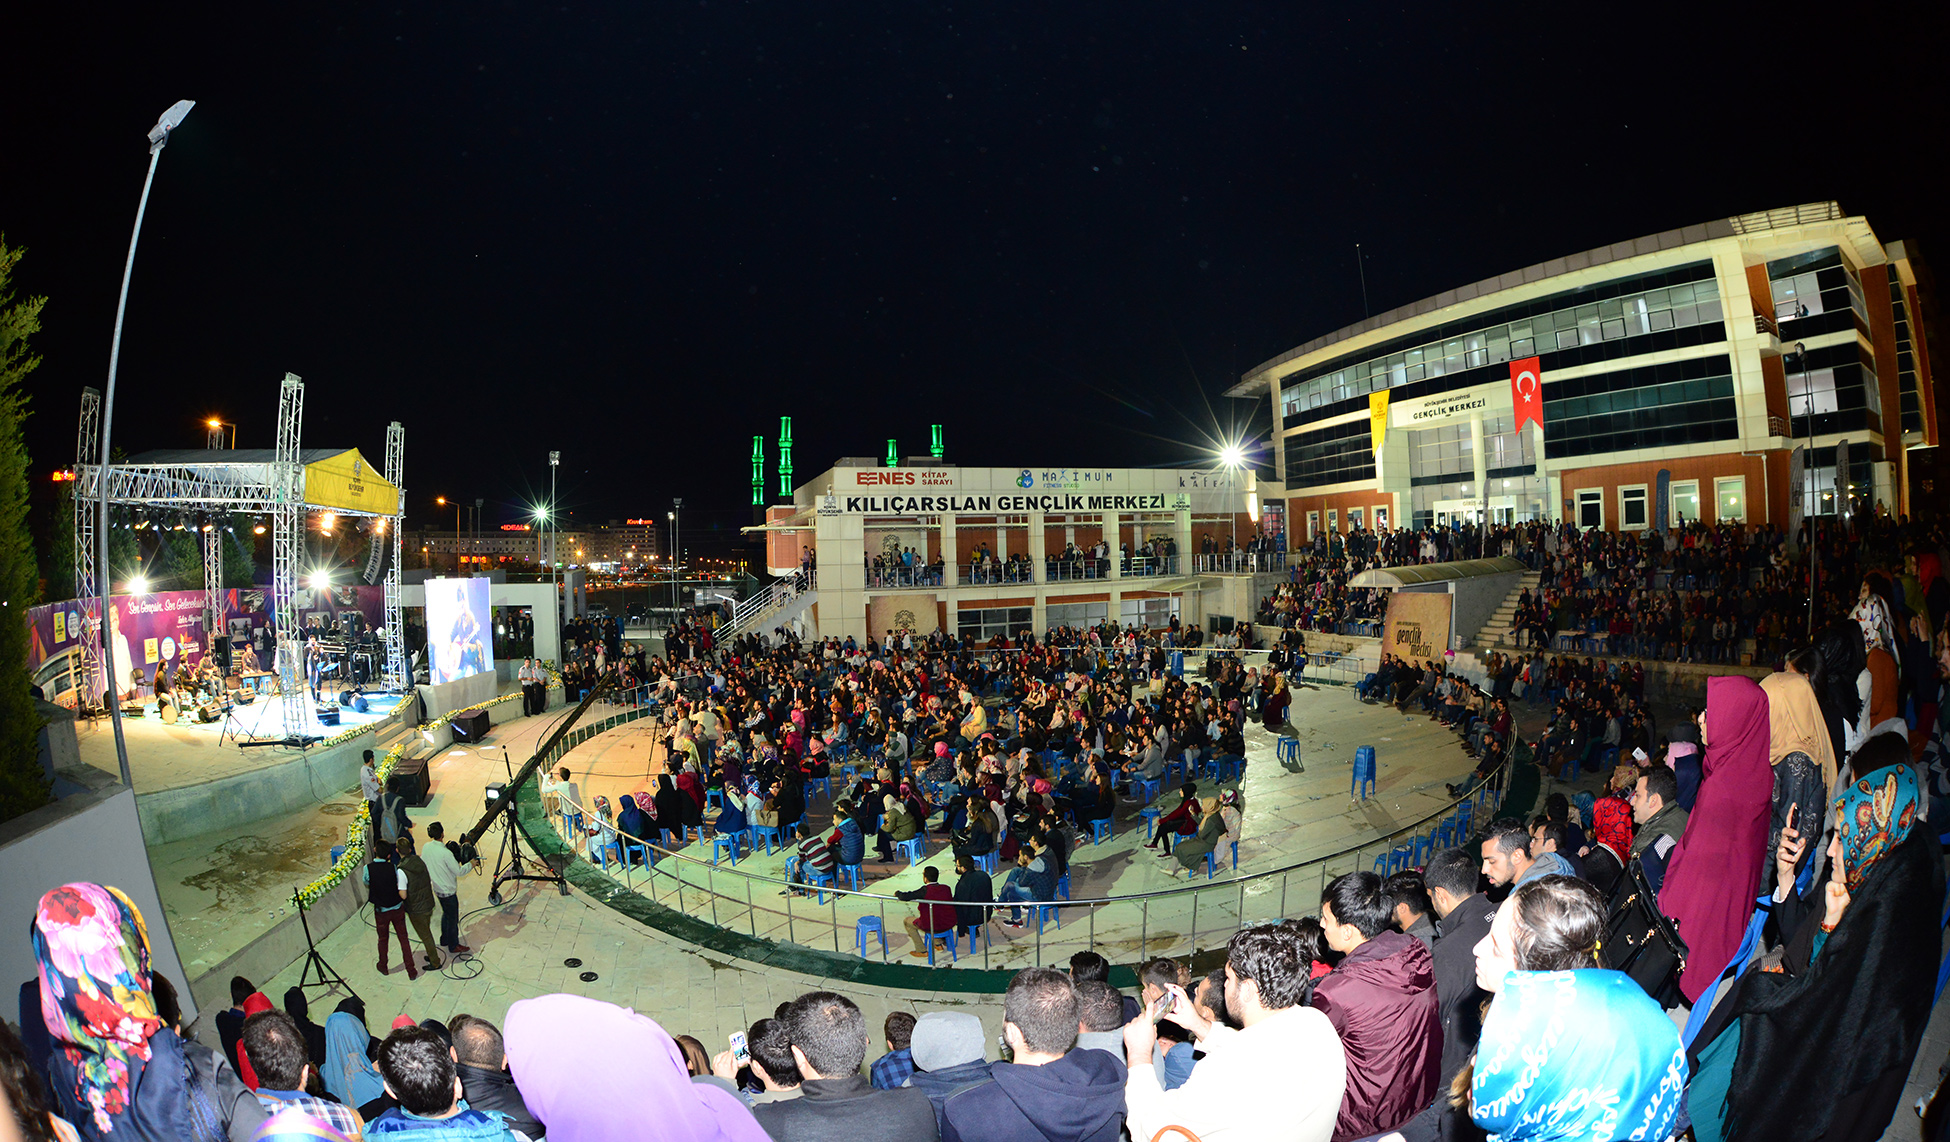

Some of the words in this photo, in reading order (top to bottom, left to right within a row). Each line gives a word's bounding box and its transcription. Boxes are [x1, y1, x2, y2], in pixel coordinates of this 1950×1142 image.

[1413, 406, 1447, 420] GENÇLİK
[1448, 398, 1486, 413] MERKEZİ
[846, 496, 991, 515] KILIÇARSLAN
[997, 493, 1084, 513] GENÇLİK
[1088, 493, 1165, 509] MERKEZİ
